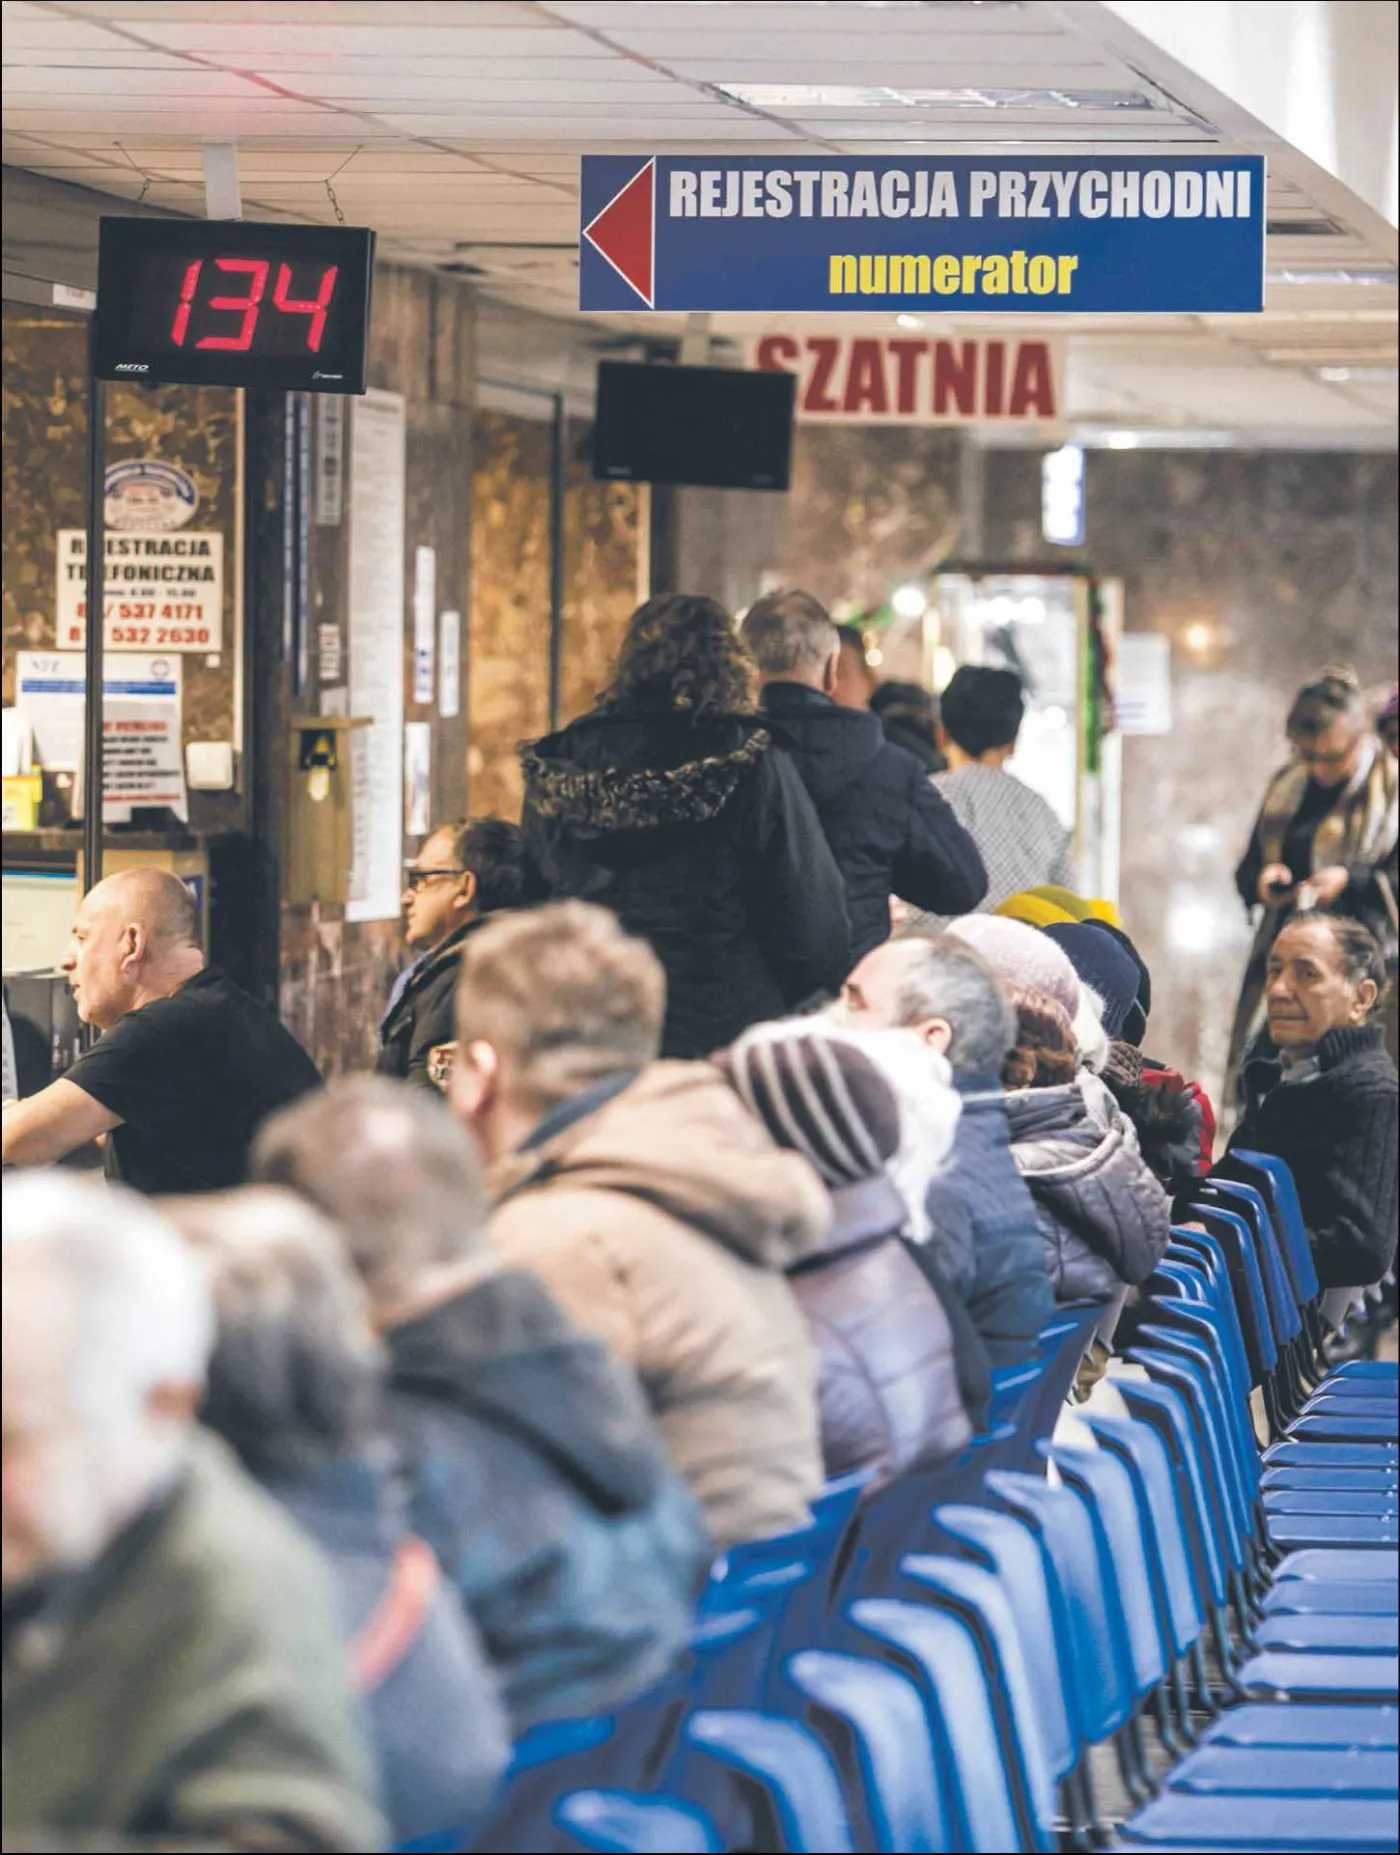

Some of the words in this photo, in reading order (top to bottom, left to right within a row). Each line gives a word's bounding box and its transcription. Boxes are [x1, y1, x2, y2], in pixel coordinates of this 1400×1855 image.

[669, 170, 959, 219] REJESTRACJA
[970, 170, 1252, 219] PRZYCHODNI
[829, 250, 1079, 294] numerator
[171, 259, 338, 352] 134
[71, 539, 210, 556] RESTRACJA
[66, 564, 215, 582] TEEFONICZNA
